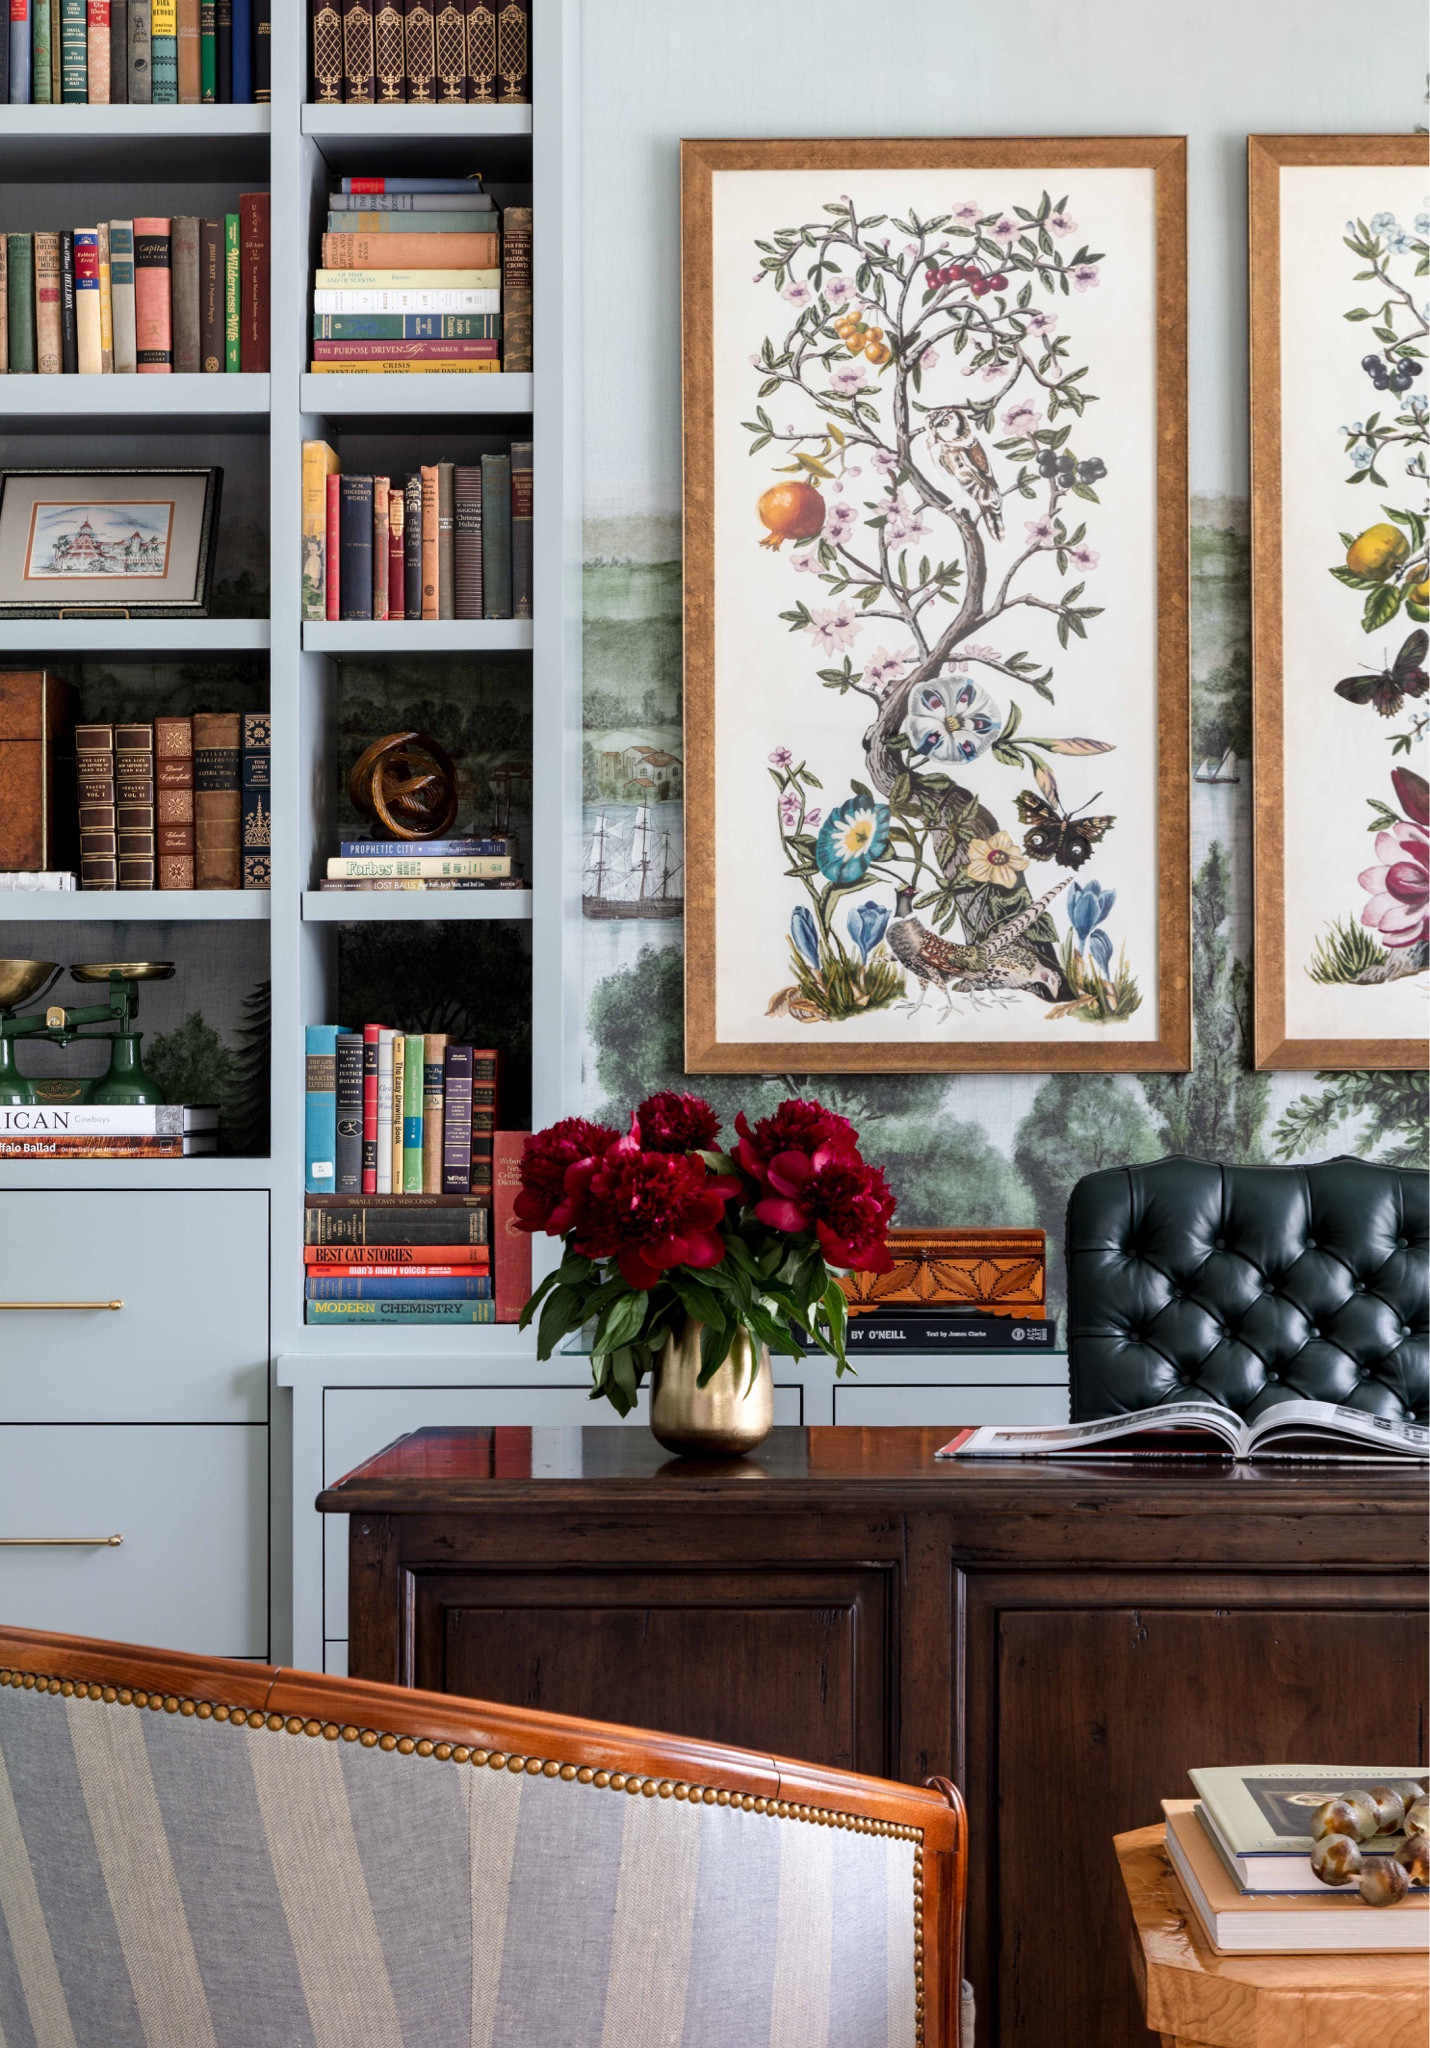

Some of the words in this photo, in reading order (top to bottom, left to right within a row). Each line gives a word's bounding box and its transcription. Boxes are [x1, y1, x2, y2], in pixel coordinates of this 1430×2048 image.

[139, 244, 168, 254] Capital
[227, 248, 239, 313] Wilderness
[64, 273, 73, 309] HELLBOX
[226, 314, 239, 342] Wife
[447, 316, 455, 337] Classics
[334, 346, 368, 354] PURPOSE
[371, 345, 403, 354] DRIVEN
[458, 521, 481, 529] Holiday
[159, 773, 191, 782] Copperfield
[350, 844, 394, 854] PROPHETIC
[396, 844, 414, 854] CITY
[346, 861, 393, 876] Forbes
[373, 881, 392, 889] LOST
[394, 881, 416, 889] BALLS
[395, 1062, 403, 1075] The
[394, 1076, 403, 1093] Easy
[394, 1095, 402, 1125] Drawing
[0, 1112, 70, 1129] ICAN
[74, 1114, 110, 1124] Cowboys
[23, 1142, 56, 1153] Ballad
[498, 1172, 522, 1180] Colleg
[315, 1247, 344, 1262] BEST
[345, 1247, 365, 1262] CAT
[367, 1247, 413, 1262] STORIES
[349, 1265, 373, 1275] man's
[375, 1265, 398, 1275] many
[399, 1265, 426, 1275] voices
[315, 1302, 376, 1313] MODERN
[380, 1303, 464, 1314] CHEMISTRY
[850, 1330, 864, 1339] BY
[868, 1330, 907, 1339] O'NEILL
[1254, 1840, 1316, 1848] ART
